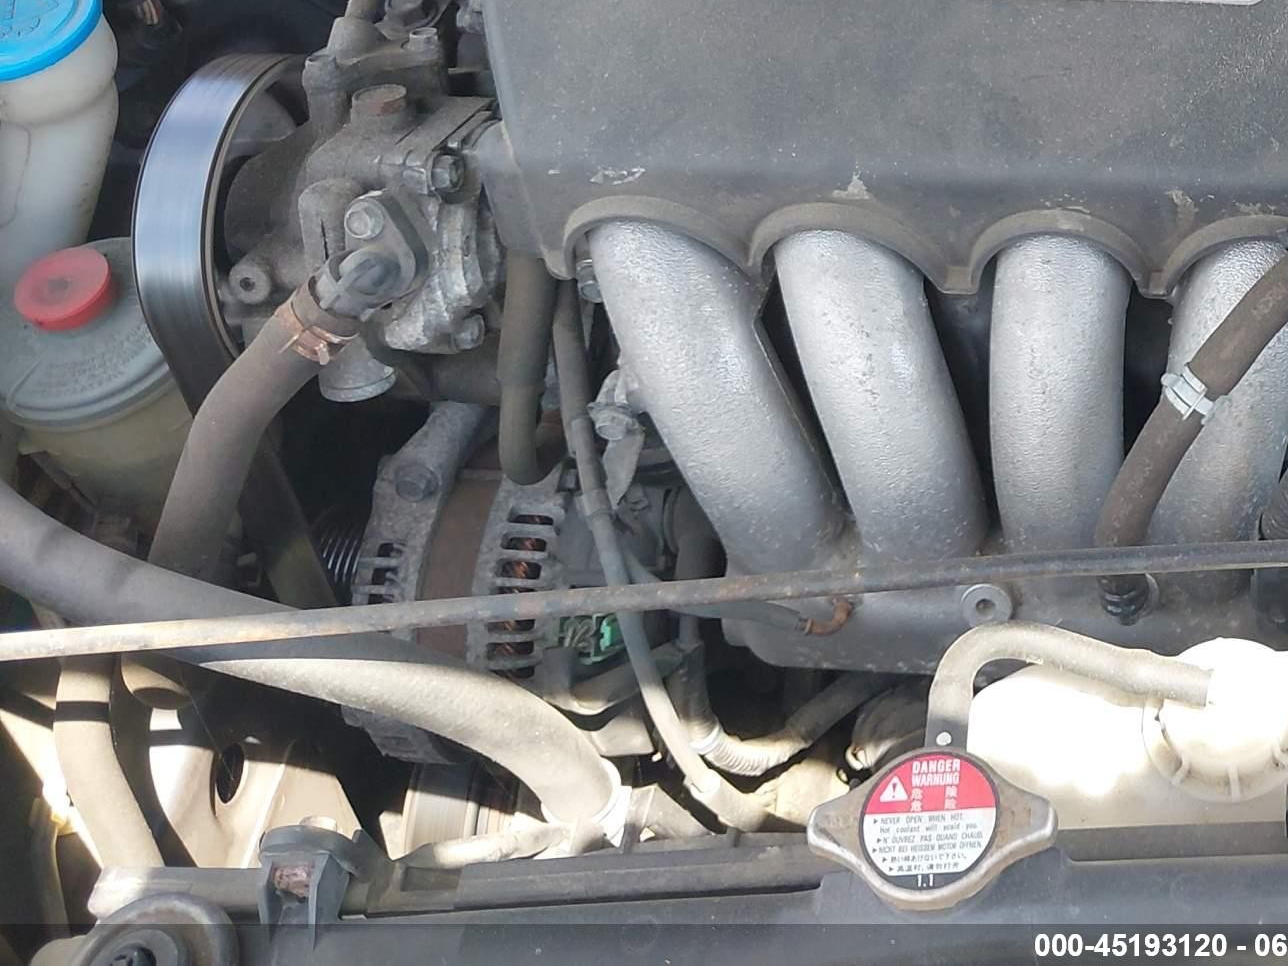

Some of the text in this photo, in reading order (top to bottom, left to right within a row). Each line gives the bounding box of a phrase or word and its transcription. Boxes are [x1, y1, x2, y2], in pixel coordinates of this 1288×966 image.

[912, 759, 961, 773] DANGER
[912, 772, 960, 786] WARNUNG
[880, 817, 900, 825] NEVER
[905, 814, 922, 823] OPEN
[928, 814, 946, 823] WHEN
[920, 834, 932, 843] PAS
[936, 833, 958, 842] QUAND
[917, 874, 933, 887] 1.1
